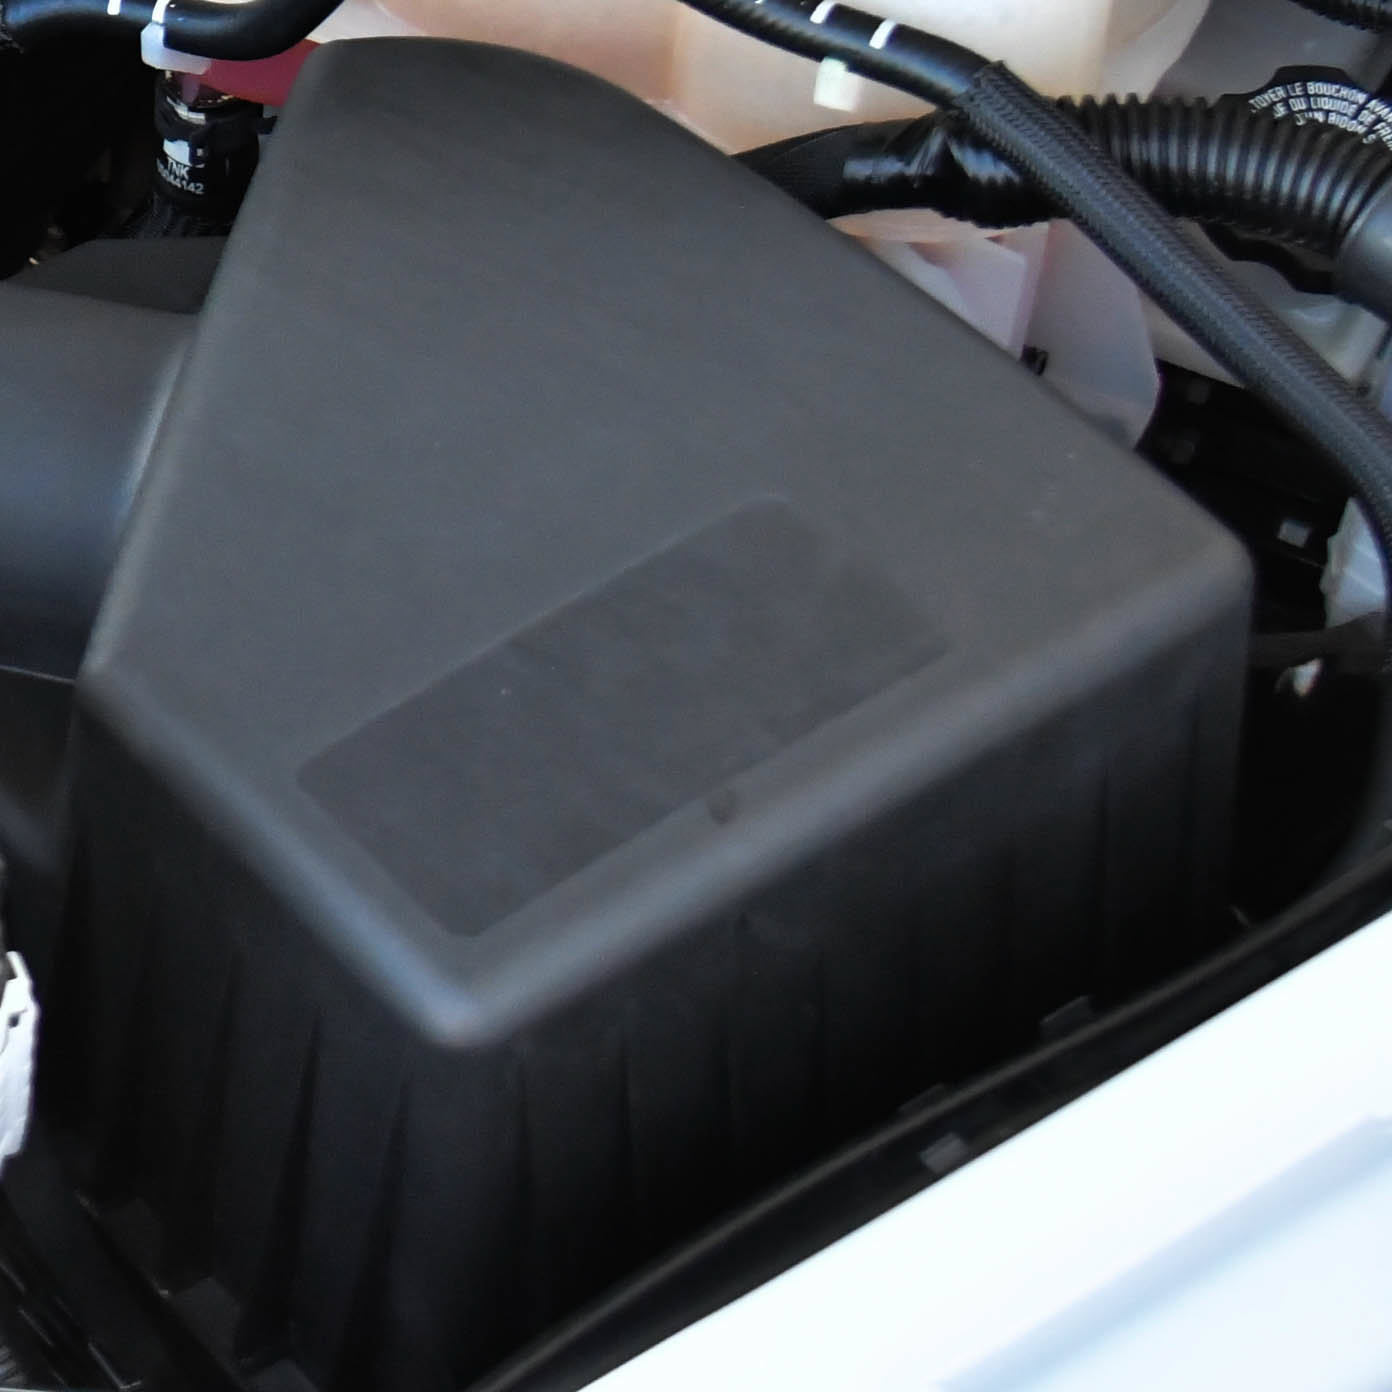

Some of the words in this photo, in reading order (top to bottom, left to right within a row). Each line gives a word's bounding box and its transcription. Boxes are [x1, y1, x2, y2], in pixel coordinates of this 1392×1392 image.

[1249, 85, 1287, 113] TOYER
[1286, 81, 1304, 96] LE
[1306, 80, 1369, 105] BOUCHON
[1289, 97, 1307, 111] DU
[1309, 96, 1358, 118] LIQUIDE
[1357, 109, 1377, 127] DE
[166, 155, 190, 180] TNK
